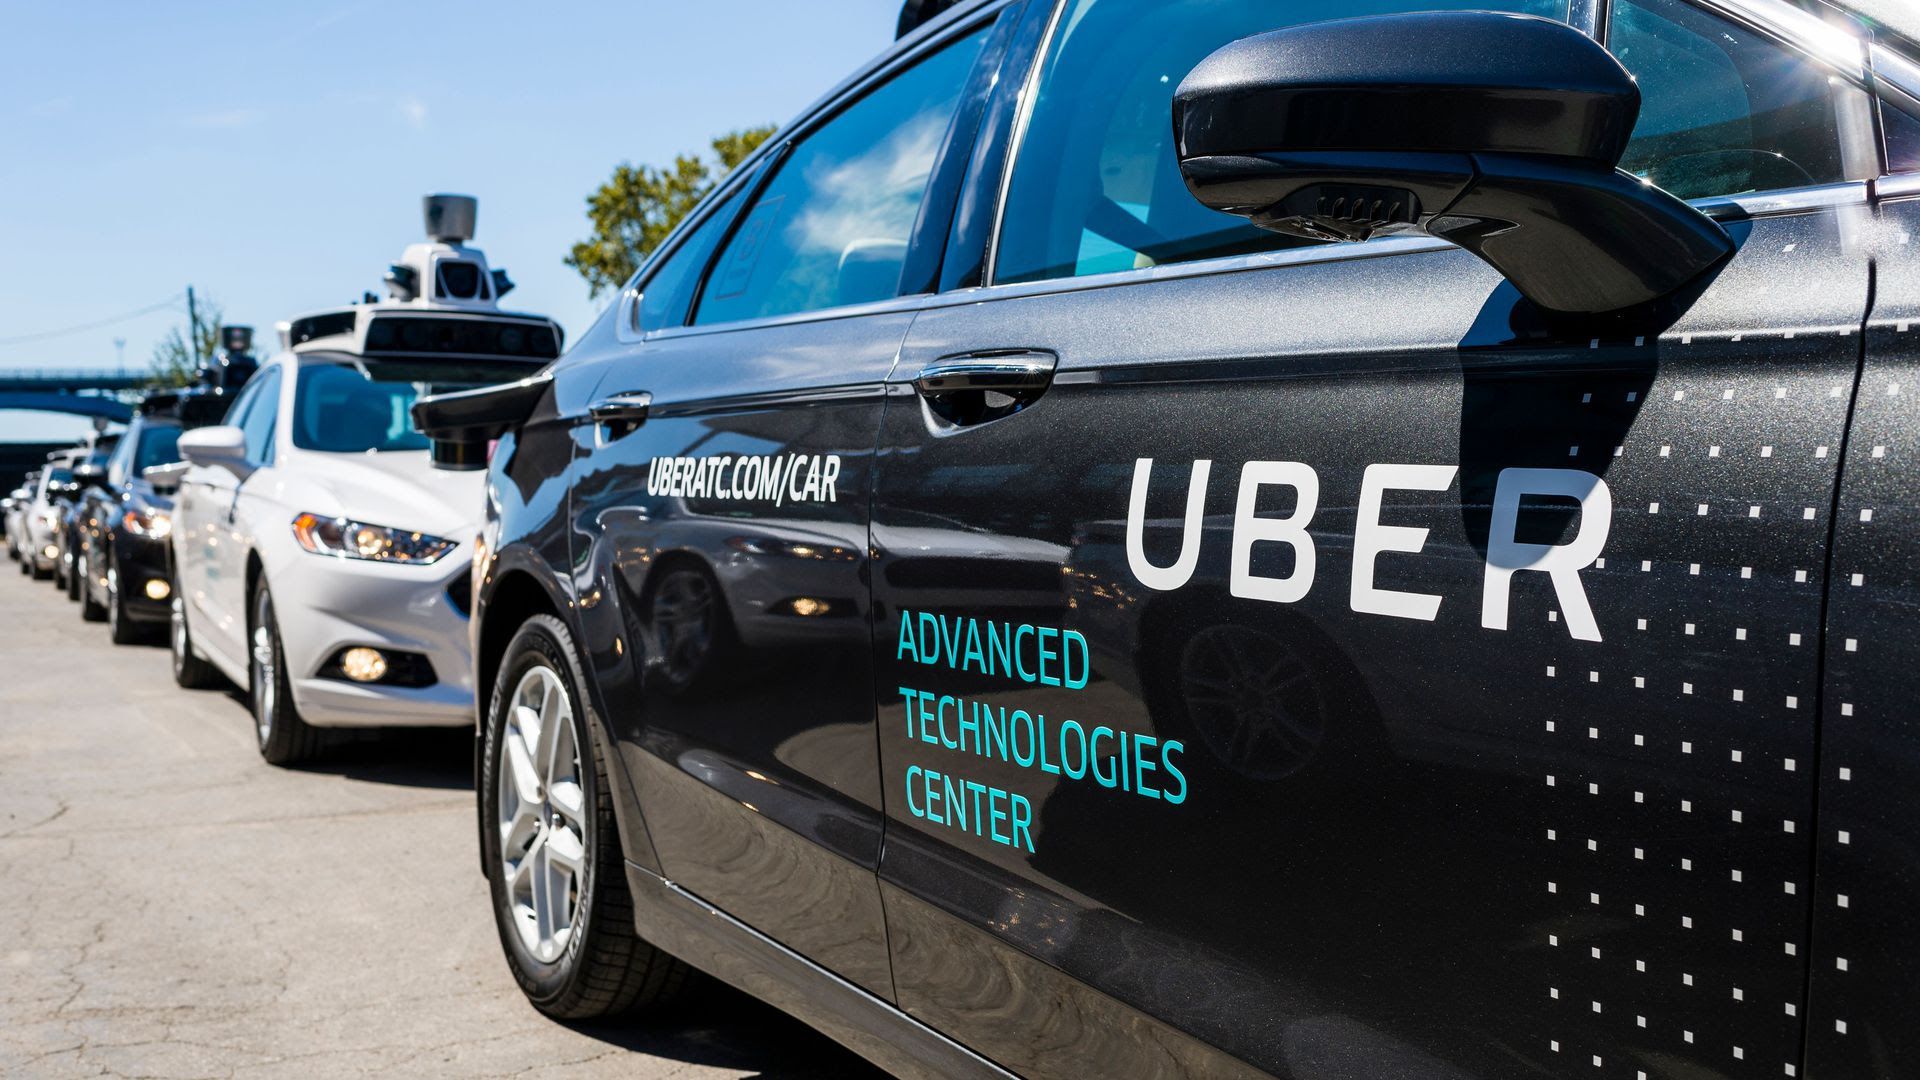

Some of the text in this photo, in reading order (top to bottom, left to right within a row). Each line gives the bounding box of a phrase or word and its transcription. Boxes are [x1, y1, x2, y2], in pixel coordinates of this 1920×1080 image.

[647, 453, 841, 508] UBERATC.COM/CAR
[1125, 457, 1613, 643] UBER
[896, 609, 1090, 691] ADVANCED
[898, 686, 1188, 805] TECHNOLOGIES
[905, 764, 1036, 854] CENTER
